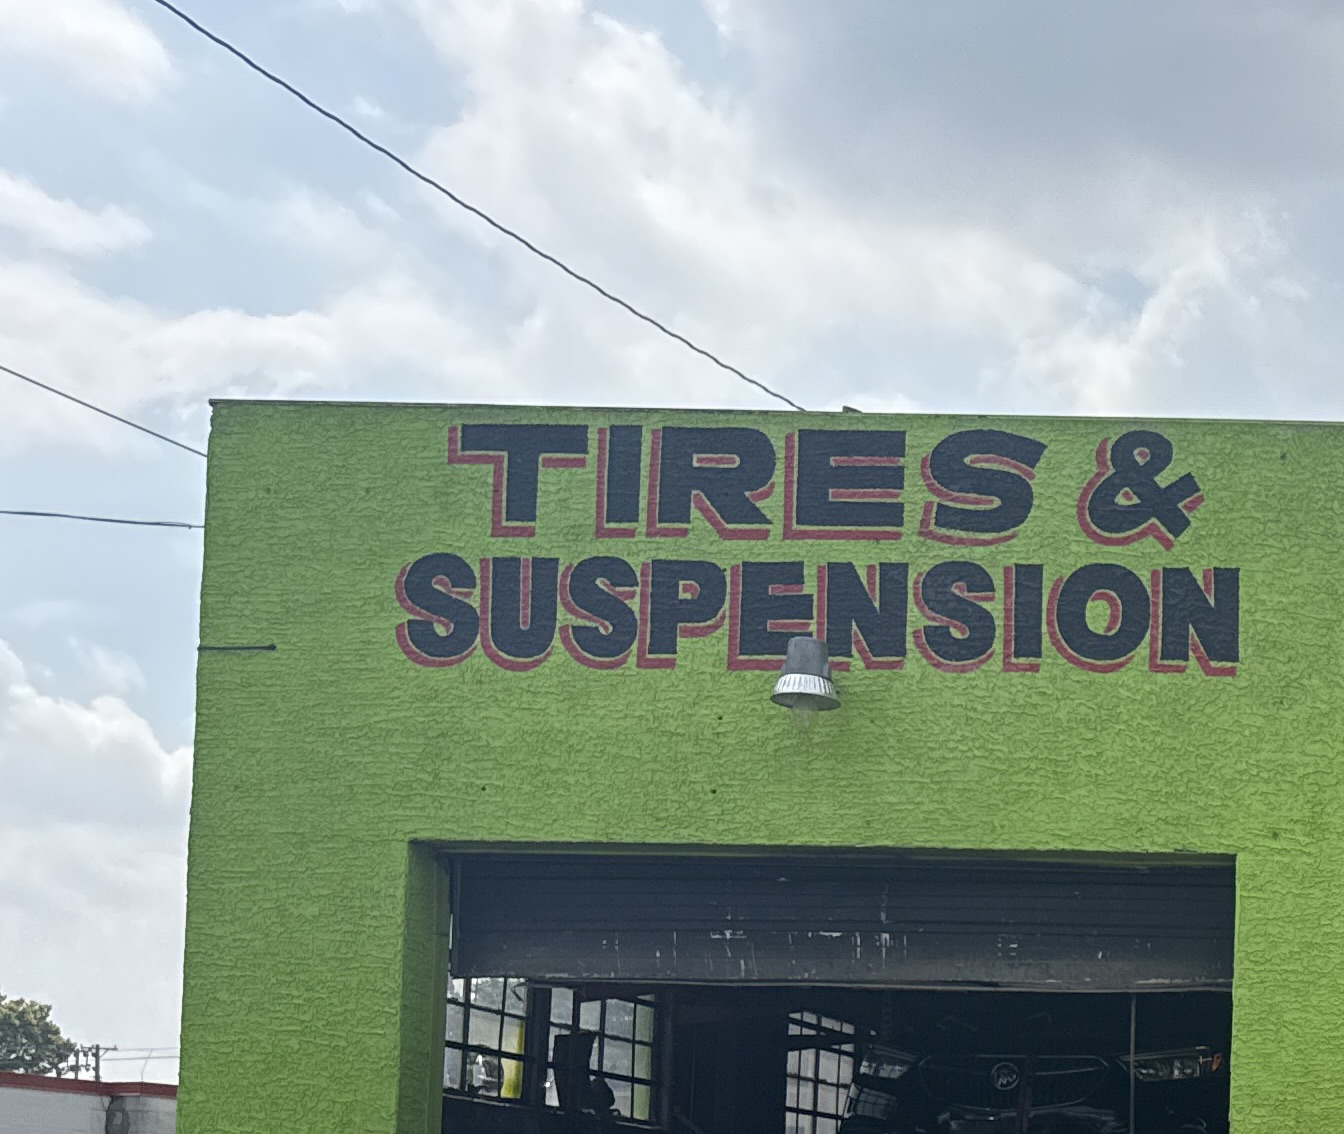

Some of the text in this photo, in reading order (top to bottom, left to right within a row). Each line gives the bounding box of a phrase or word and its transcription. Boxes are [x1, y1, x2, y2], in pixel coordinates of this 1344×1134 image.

[448, 423, 1205, 551] TIRES &
[396, 552, 1240, 677] SUSPENSION
